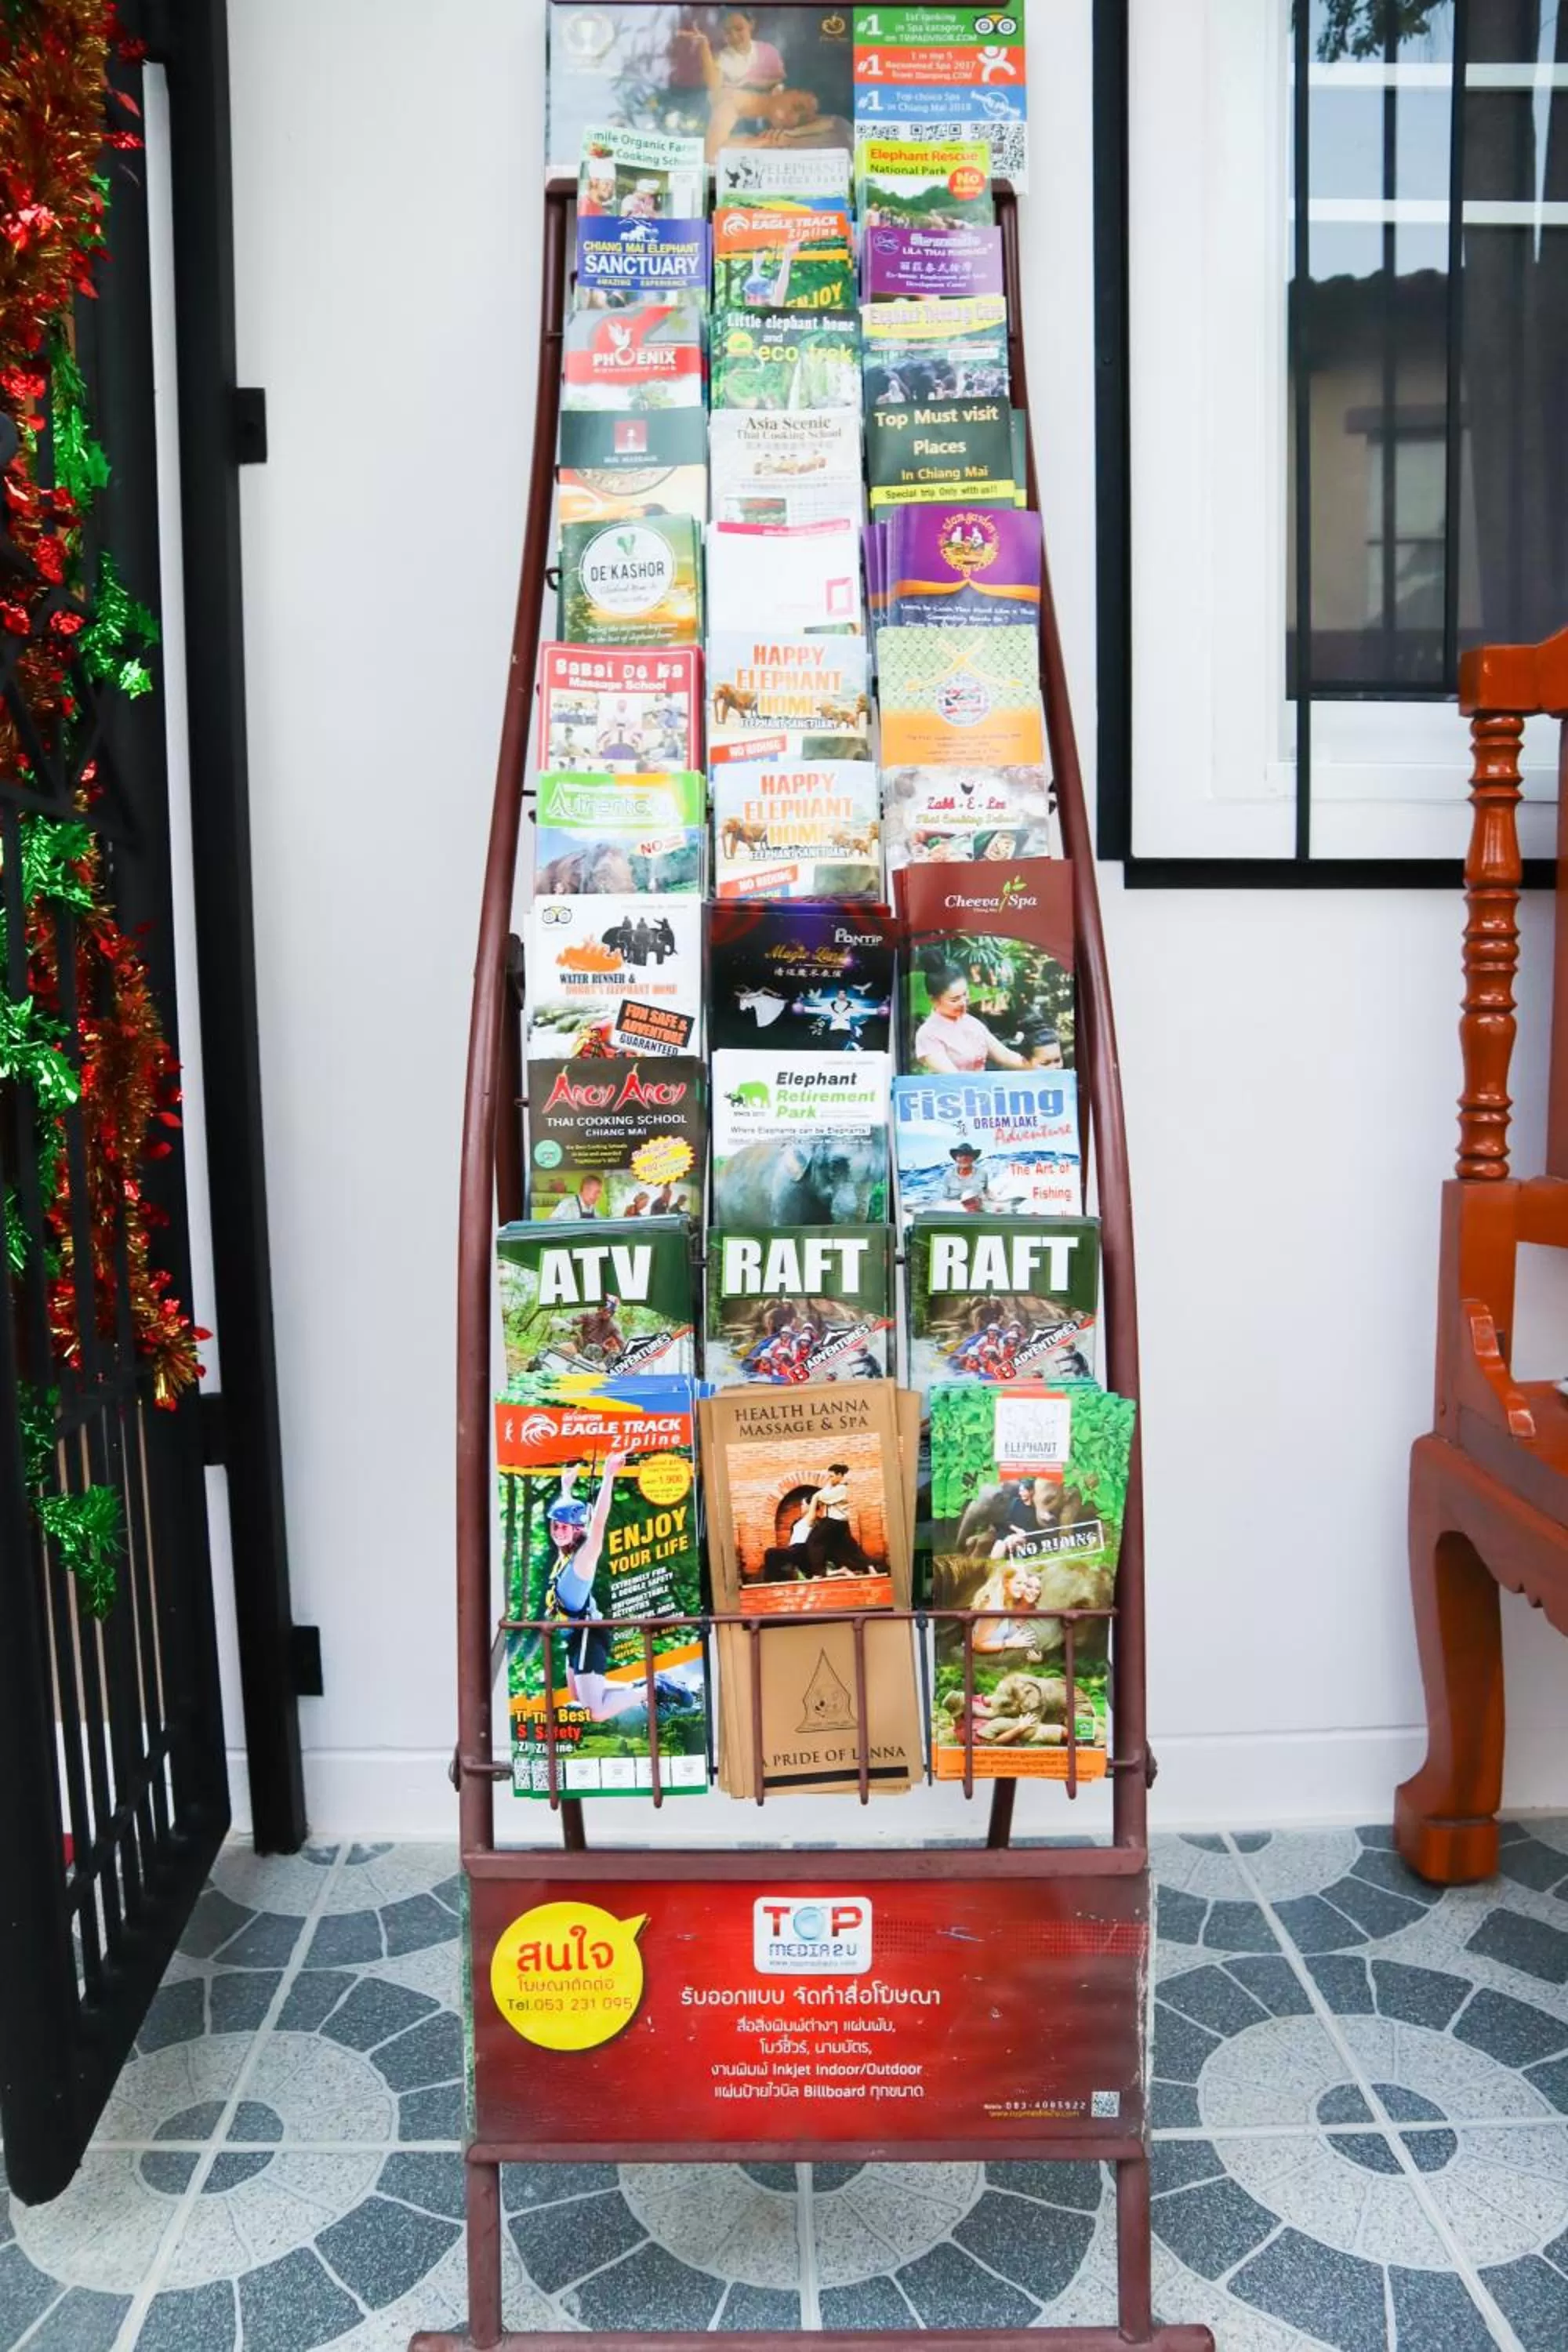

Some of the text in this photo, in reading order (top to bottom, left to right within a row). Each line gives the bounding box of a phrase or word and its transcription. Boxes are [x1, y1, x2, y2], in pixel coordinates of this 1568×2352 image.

[621, 134, 666, 151] Organic
[616, 148, 659, 166] Cooking
[870, 148, 979, 165] Elephant Rescue
[870, 165, 946, 176] National Park
[796, 216, 838, 227] TRACK
[583, 241, 699, 254] CHIANG MAI ELEPHANT
[902, 247, 921, 256] LILA
[924, 247, 946, 256] THAI
[584, 255, 700, 275] SANCTUARY
[727, 313, 855, 332] Little elephant home
[592, 346, 677, 367] PHOENIX
[758, 345, 799, 361] eco
[746, 416, 831, 430] Asia Scenic
[874, 405, 1000, 430] Top Must visit
[913, 439, 967, 456] Places
[902, 465, 989, 481] In Chiang Mai
[885, 488, 916, 499] Special
[753, 644, 826, 666] HAPPY
[568, 677, 666, 691] Massage School
[736, 669, 841, 691] ELEPHANT
[760, 773, 835, 796] HAPPY
[743, 797, 854, 821] ELEPHANT
[640, 839, 663, 854] NO
[944, 893, 1038, 909] Cheeva Spa
[559, 972, 636, 985] WATER RUNNER &
[625, 1003, 688, 1031] FUN SAFE &
[621, 1021, 685, 1046] ADVENTURE
[619, 1033, 679, 1056] GUARANTEED
[775, 1072, 858, 1087] Elephant
[775, 1089, 877, 1103] Retirement
[896, 1086, 1065, 1123] Fishing
[546, 1113, 688, 1127] THAI COOKING SCHOOL
[775, 1105, 817, 1119] Park
[757, 1126, 797, 1135] Elephants
[973, 1115, 1039, 1130] DREAM LAKE
[585, 1127, 647, 1138] CHIANG MAI
[993, 1123, 1073, 1148] Adventure
[1010, 1160, 1071, 1177] The Art of
[1032, 1186, 1073, 1202] Fishing
[723, 1237, 869, 1295] RAFT
[931, 1234, 1080, 1292] RAFT
[539, 1244, 653, 1305] ATV
[807, 1324, 870, 1370] ADVENTURES
[1014, 1322, 1079, 1367] ADVENTURES
[608, 1333, 672, 1376] ADVENTURES
[734, 1399, 871, 1422] HEALTH LANNA
[561, 1417, 681, 1436] EAGLE TRACK
[739, 1420, 814, 1437] MASSAGE
[820, 1417, 833, 1430] &
[611, 1433, 681, 1449] Zipline
[1004, 1441, 1058, 1454] ELEPHANT
[608, 1506, 687, 1556] ENJOY
[1015, 1533, 1098, 1558] NO RIDING
[608, 1535, 688, 1576] YOUR LIFE
[558, 1708, 591, 1723] Best
[534, 1726, 582, 1740] Sfety
[773, 1746, 906, 1766] PRIDE OF LNNA
[762, 1905, 864, 1940] TOP
[516, 1924, 615, 1973] สนใจ
[681, 1979, 941, 2006] รับออกแบบ จัดทำสื่อโฆษณา
[570, 1996, 596, 2011] 231
[603, 1995, 633, 2011] 095
[772, 2063, 812, 2078] Inkjet
[815, 2062, 923, 2077] Indoor/Outdoor
[803, 2085, 866, 2098] Billboard
